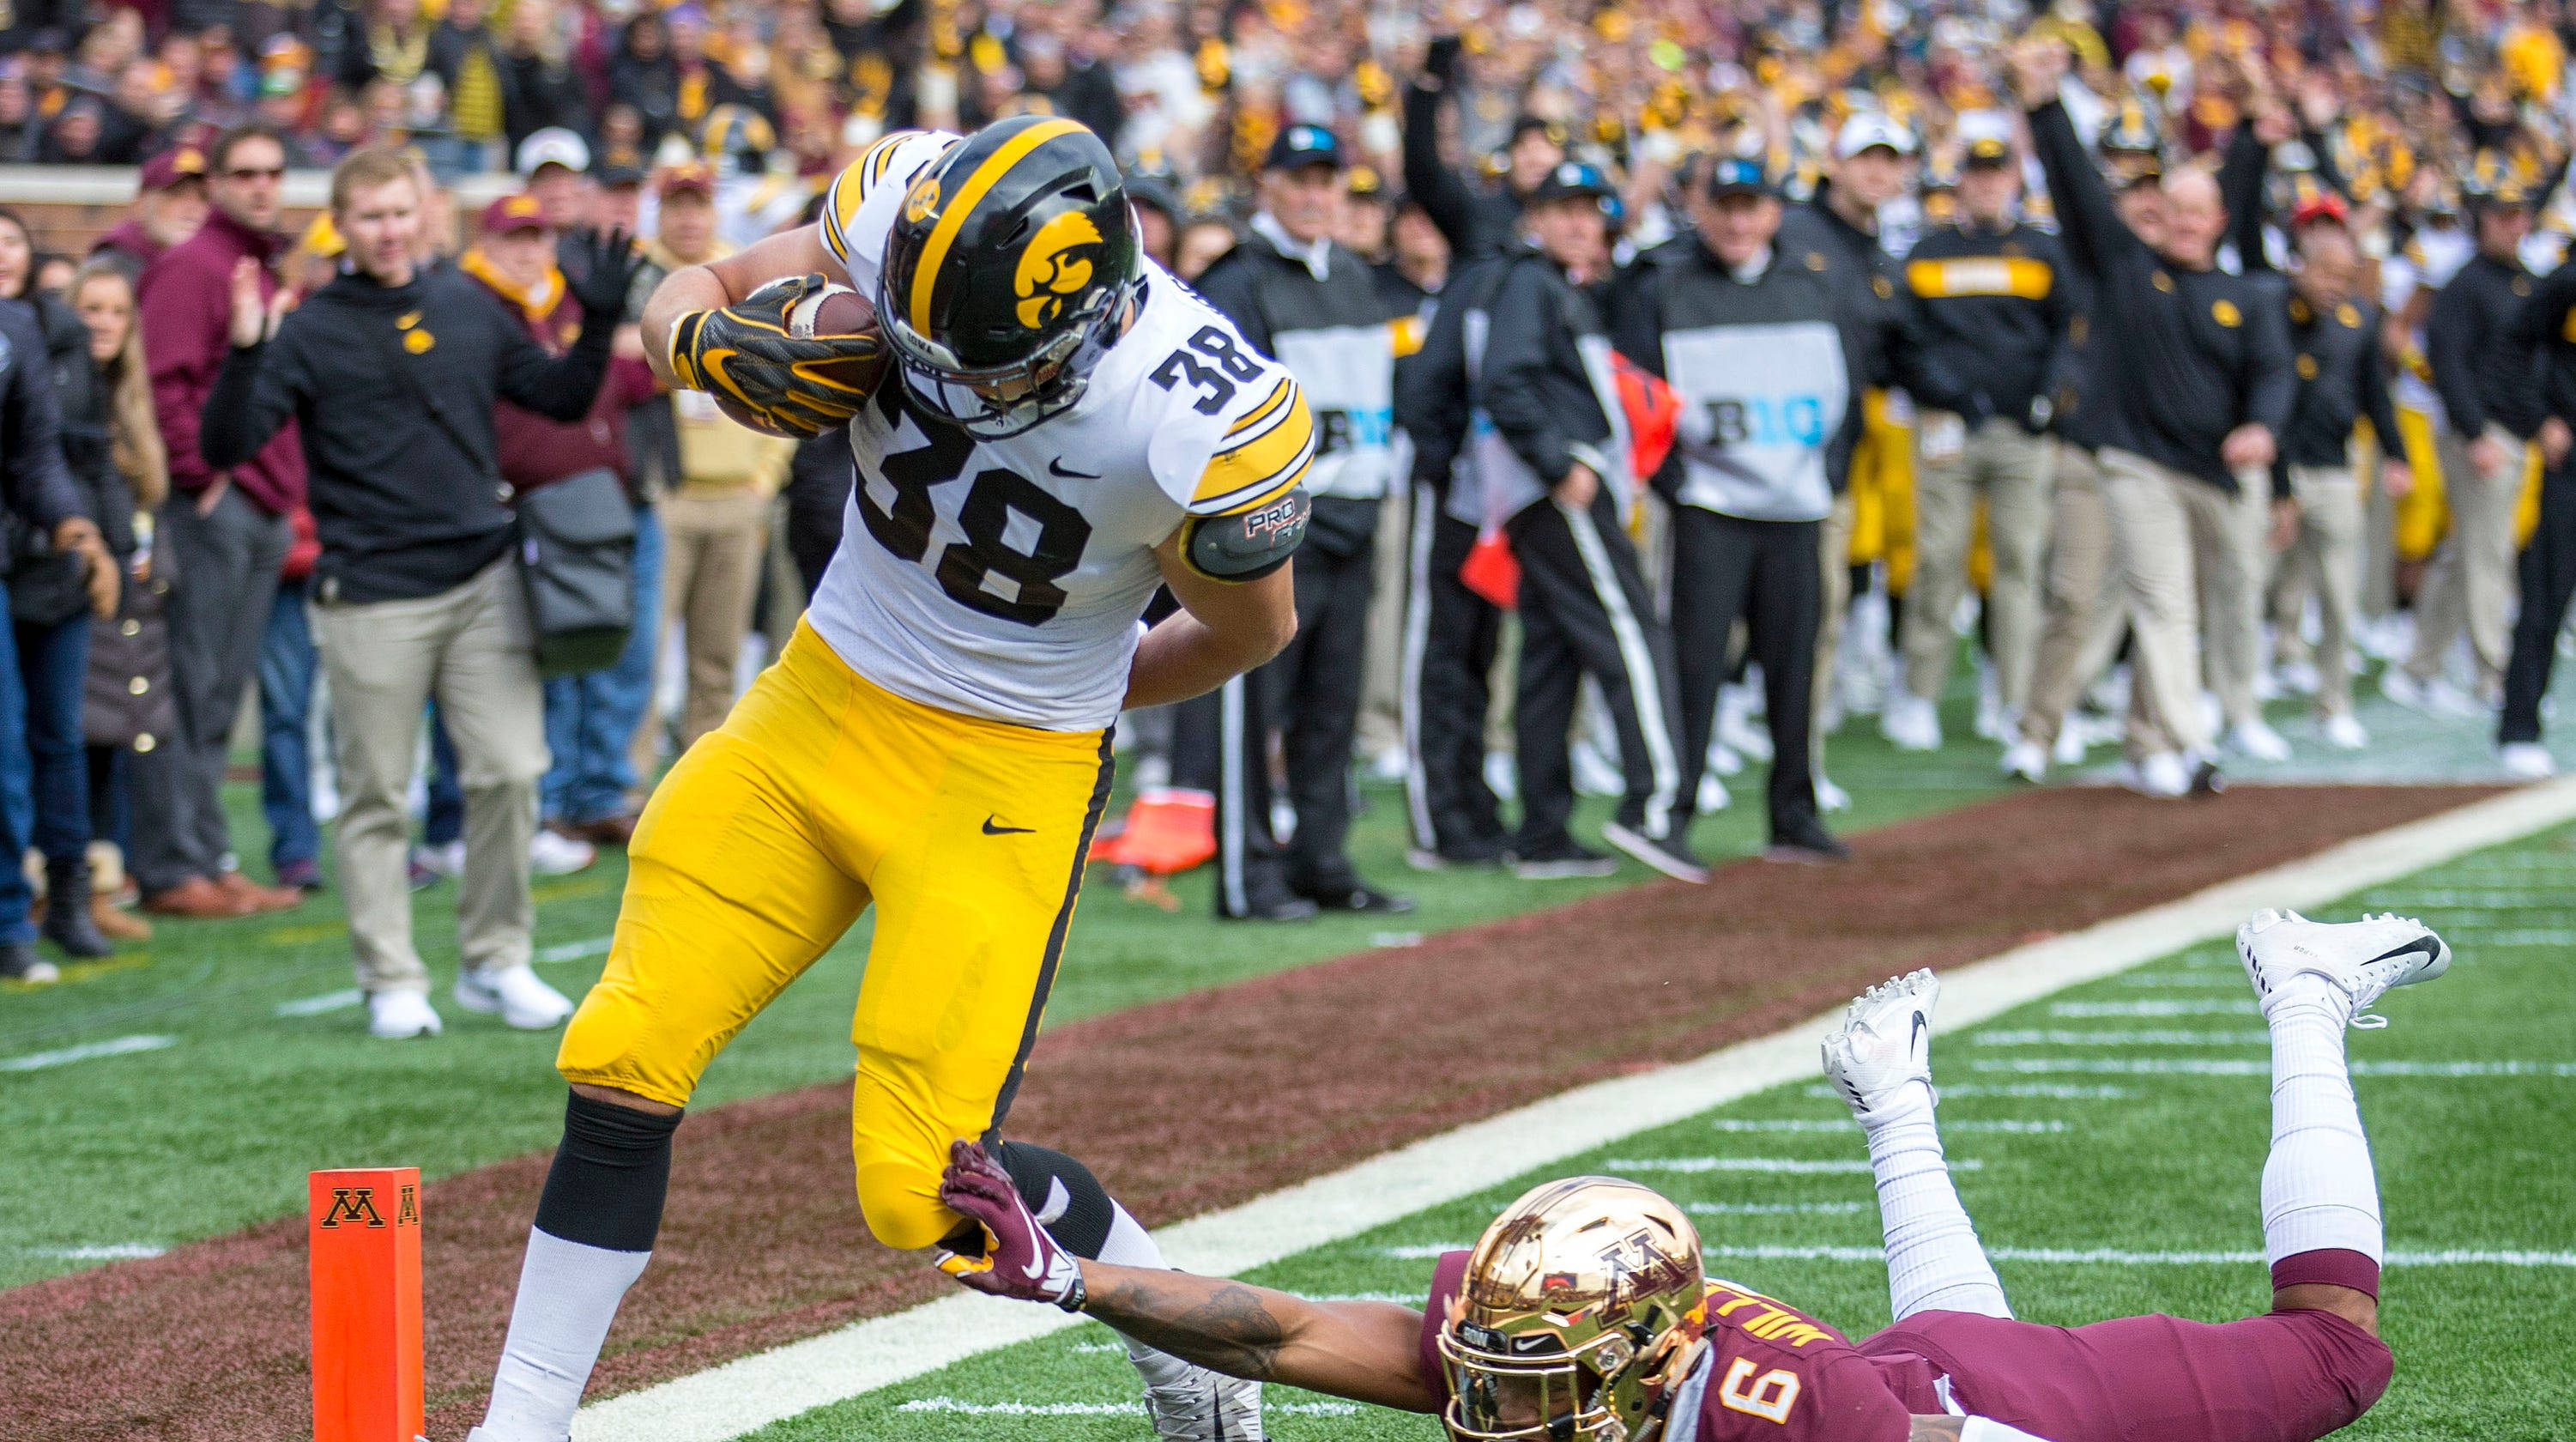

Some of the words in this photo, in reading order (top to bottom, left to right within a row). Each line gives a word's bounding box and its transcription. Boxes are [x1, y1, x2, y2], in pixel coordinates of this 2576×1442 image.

[1148, 324, 1266, 416] 38
[855, 362, 1093, 627] 38
[1244, 500, 1295, 537] PRO
[320, 1188, 387, 1228] M
[1593, 1227, 1697, 1330] M
[1718, 1356, 1801, 1425] 6
